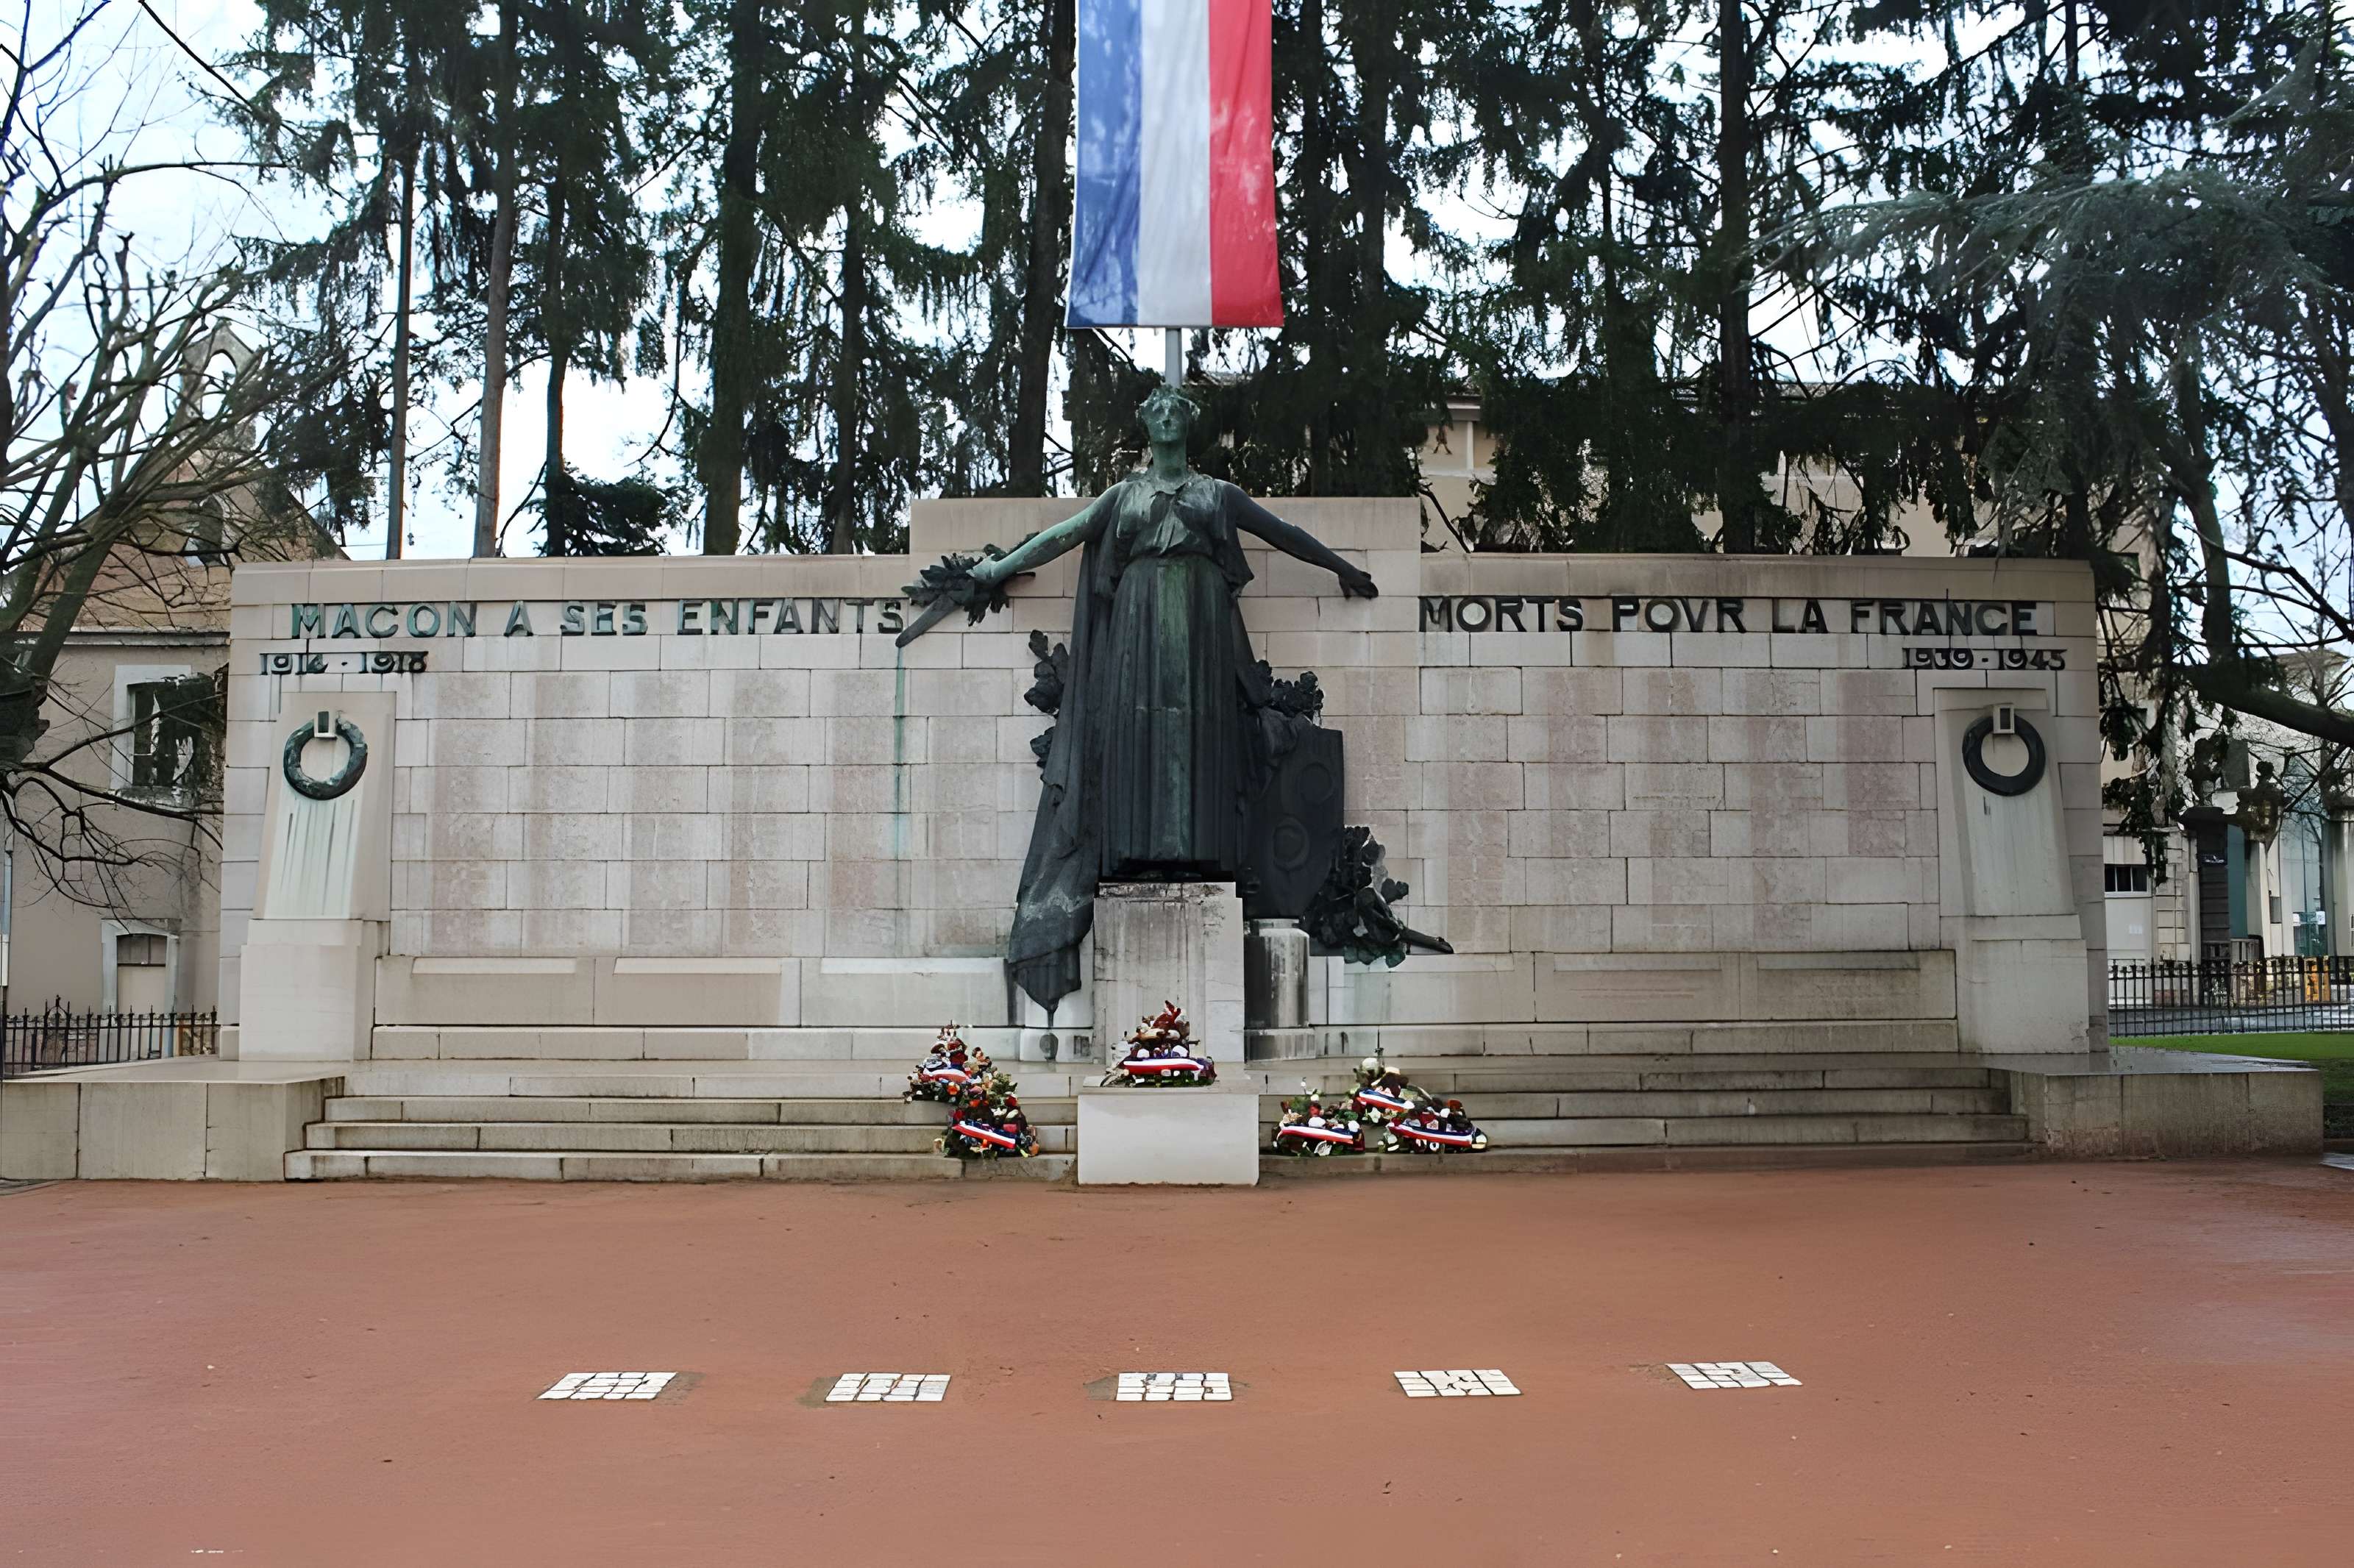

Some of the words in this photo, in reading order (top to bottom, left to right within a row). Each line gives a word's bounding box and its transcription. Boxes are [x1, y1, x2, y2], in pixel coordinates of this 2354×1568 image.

[292, 602, 477, 638] MACON
[504, 599, 533, 637] A
[560, 600, 648, 635] SES
[677, 599, 904, 635] ENFANTS
[1419, 596, 1583, 632] MORTS
[1612, 597, 1746, 633] POVR
[1772, 598, 1828, 634] LA
[1850, 600, 2038, 635] FRANCE
